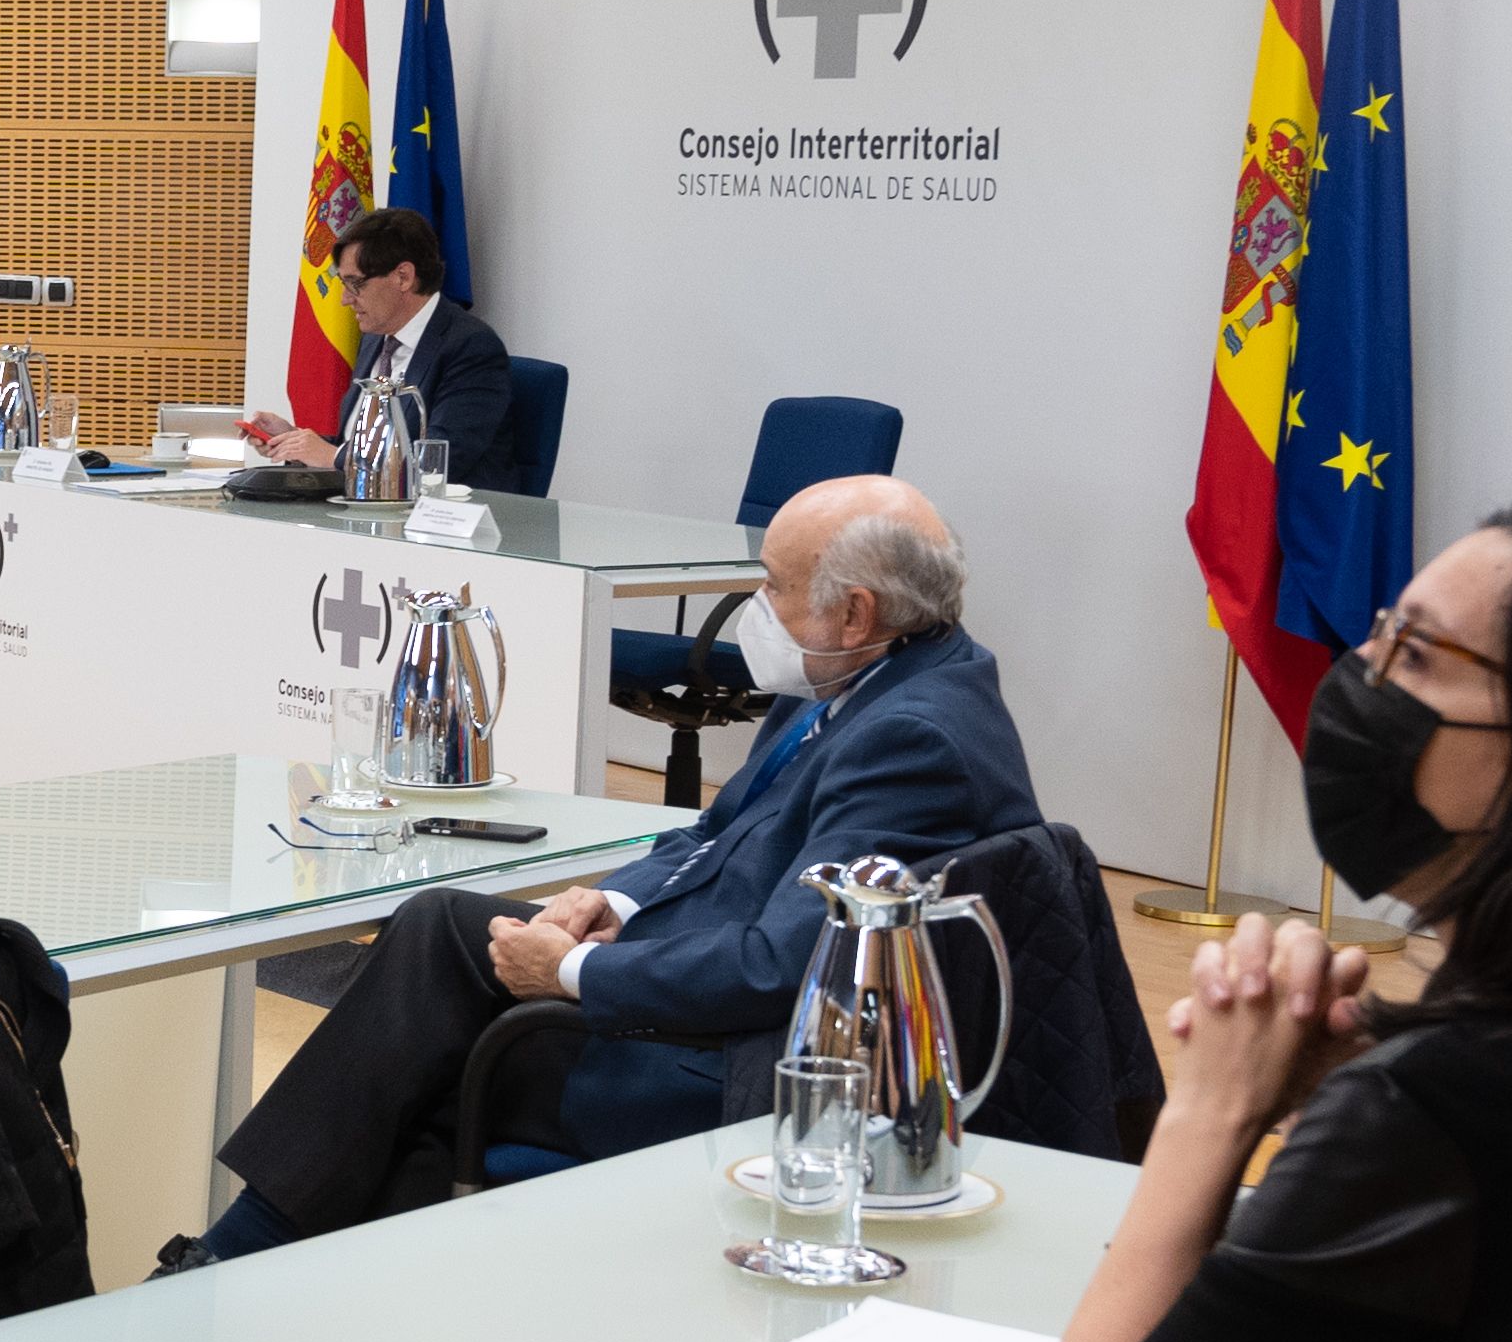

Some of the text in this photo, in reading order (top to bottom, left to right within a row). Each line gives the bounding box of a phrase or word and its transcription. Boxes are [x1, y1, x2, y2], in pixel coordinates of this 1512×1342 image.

[678, 126, 1000, 166] Consejo Interterritorial
[677, 173, 998, 202] SISTEMA NACIONAL DE SALUD
[3, 641, 28, 658] SALUD
[278, 678, 326, 706] Consejo
[277, 702, 318, 723] SISTEMA
